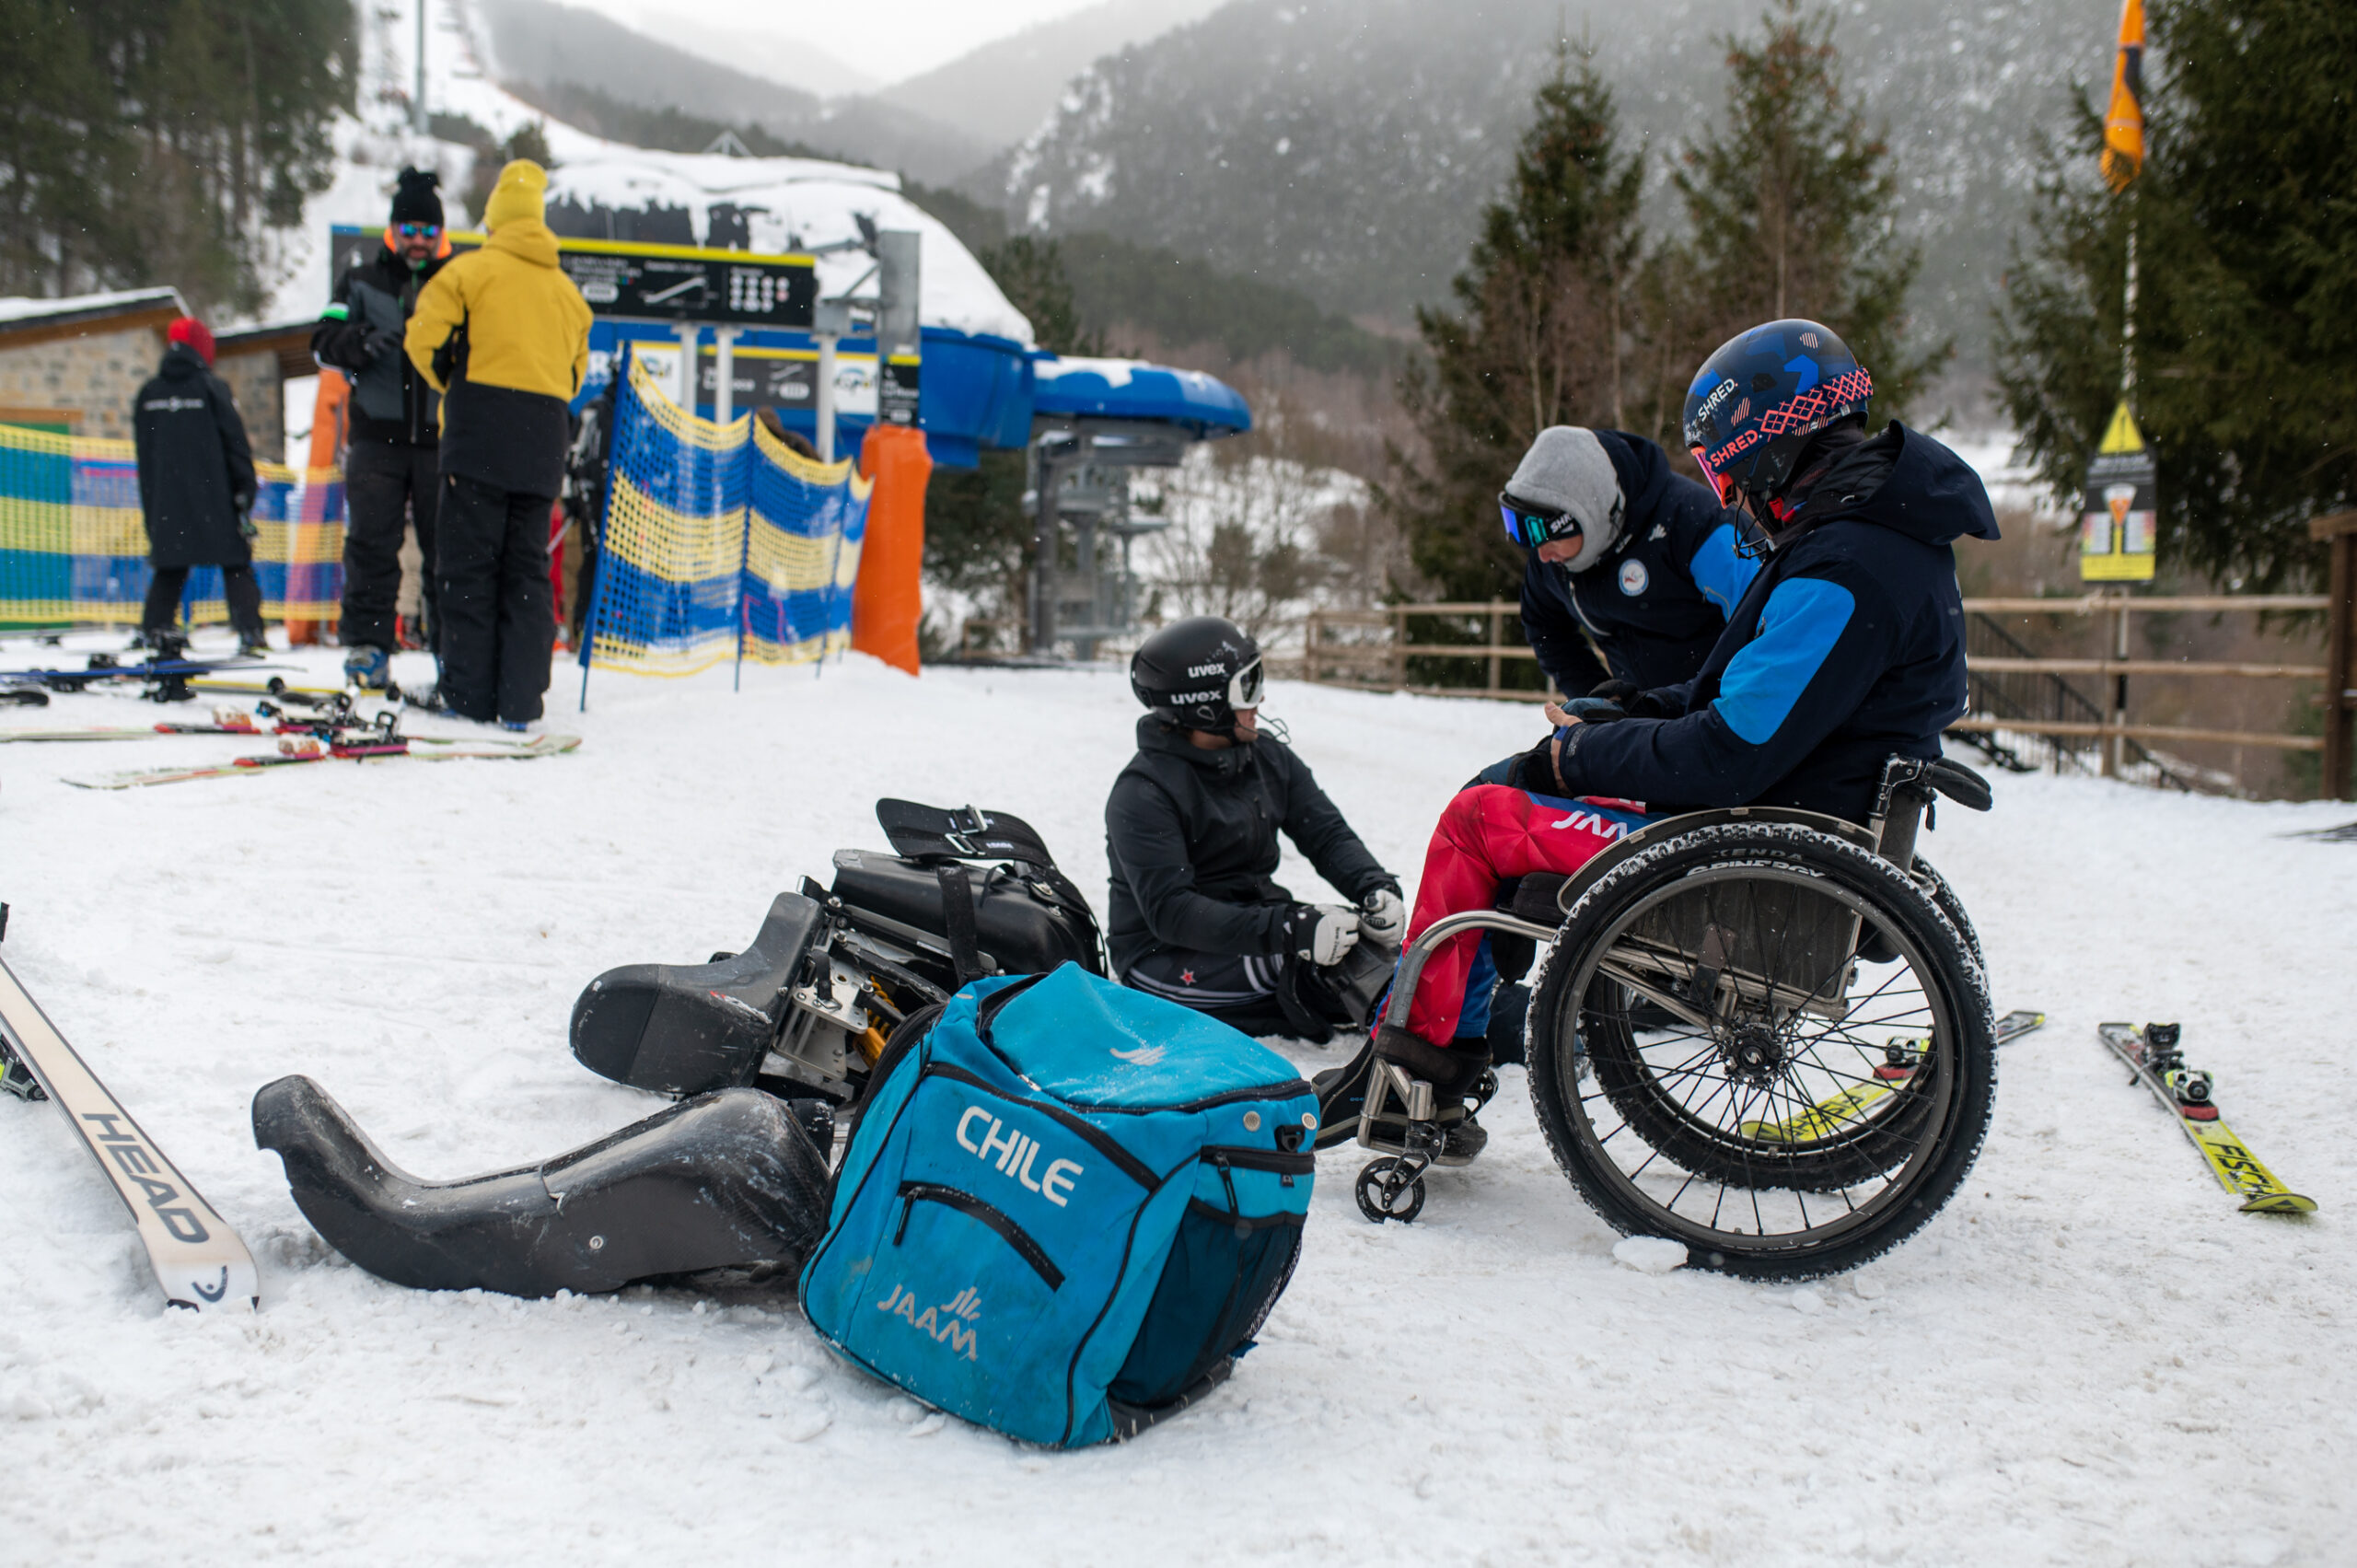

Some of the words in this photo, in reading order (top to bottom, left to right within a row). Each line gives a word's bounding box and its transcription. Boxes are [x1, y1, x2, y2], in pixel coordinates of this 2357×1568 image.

[1698, 378, 1738, 422] SHRED.
[1710, 429, 1763, 468] SHRED.
[1550, 513, 1574, 534] SHR
[1188, 663, 1225, 679] uvex
[1170, 691, 1222, 705] uvex
[1550, 810, 1628, 839] JAA
[956, 1106, 1084, 1208] CHILE
[81, 1112, 210, 1244] HEAD
[877, 1283, 978, 1362] JAAM
